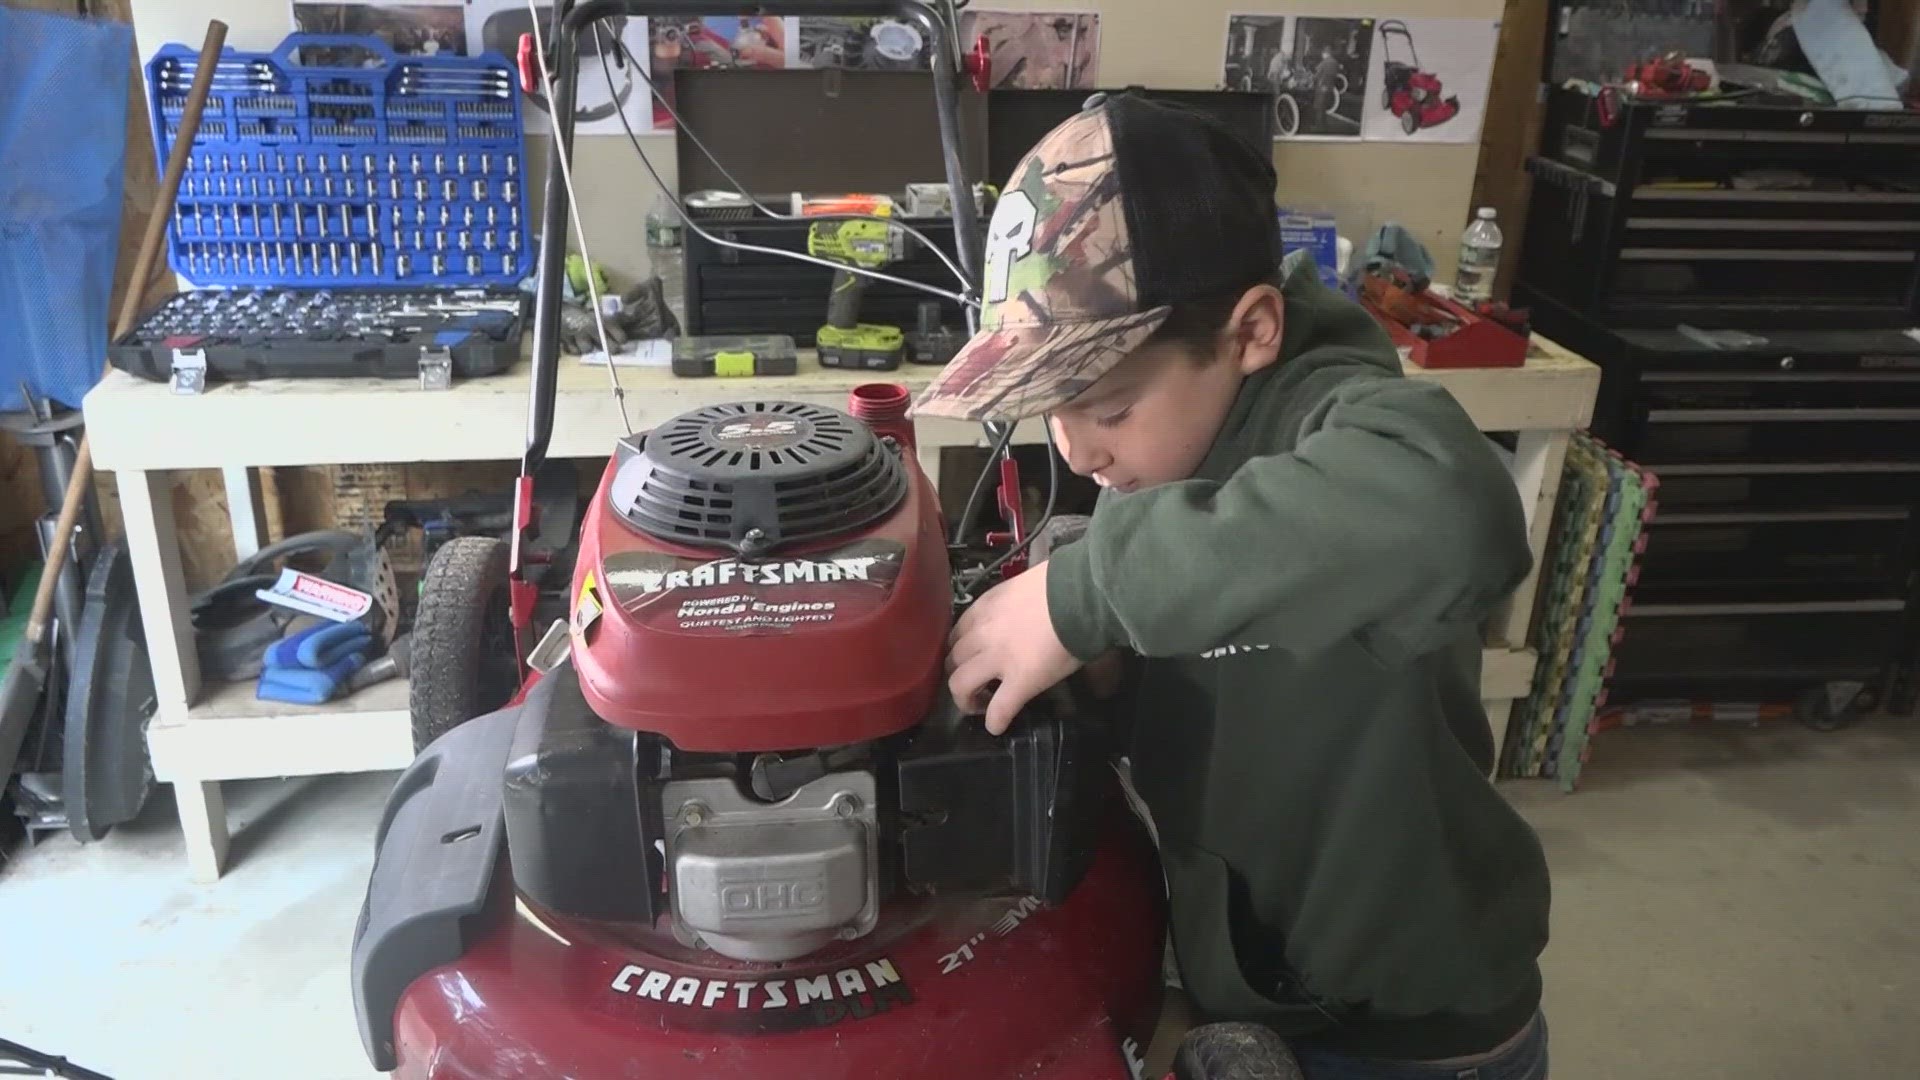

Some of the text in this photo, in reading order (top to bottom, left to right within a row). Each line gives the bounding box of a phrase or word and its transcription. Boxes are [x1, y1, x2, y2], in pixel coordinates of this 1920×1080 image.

[677, 601, 836, 618] Honda Engines
[682, 595, 741, 607] POWERED
[743, 615, 772, 623] AND
[774, 614, 835, 623] LIGHTEST
[721, 884, 823, 911] OHC
[611, 958, 901, 1009] CRAFTSMAN
